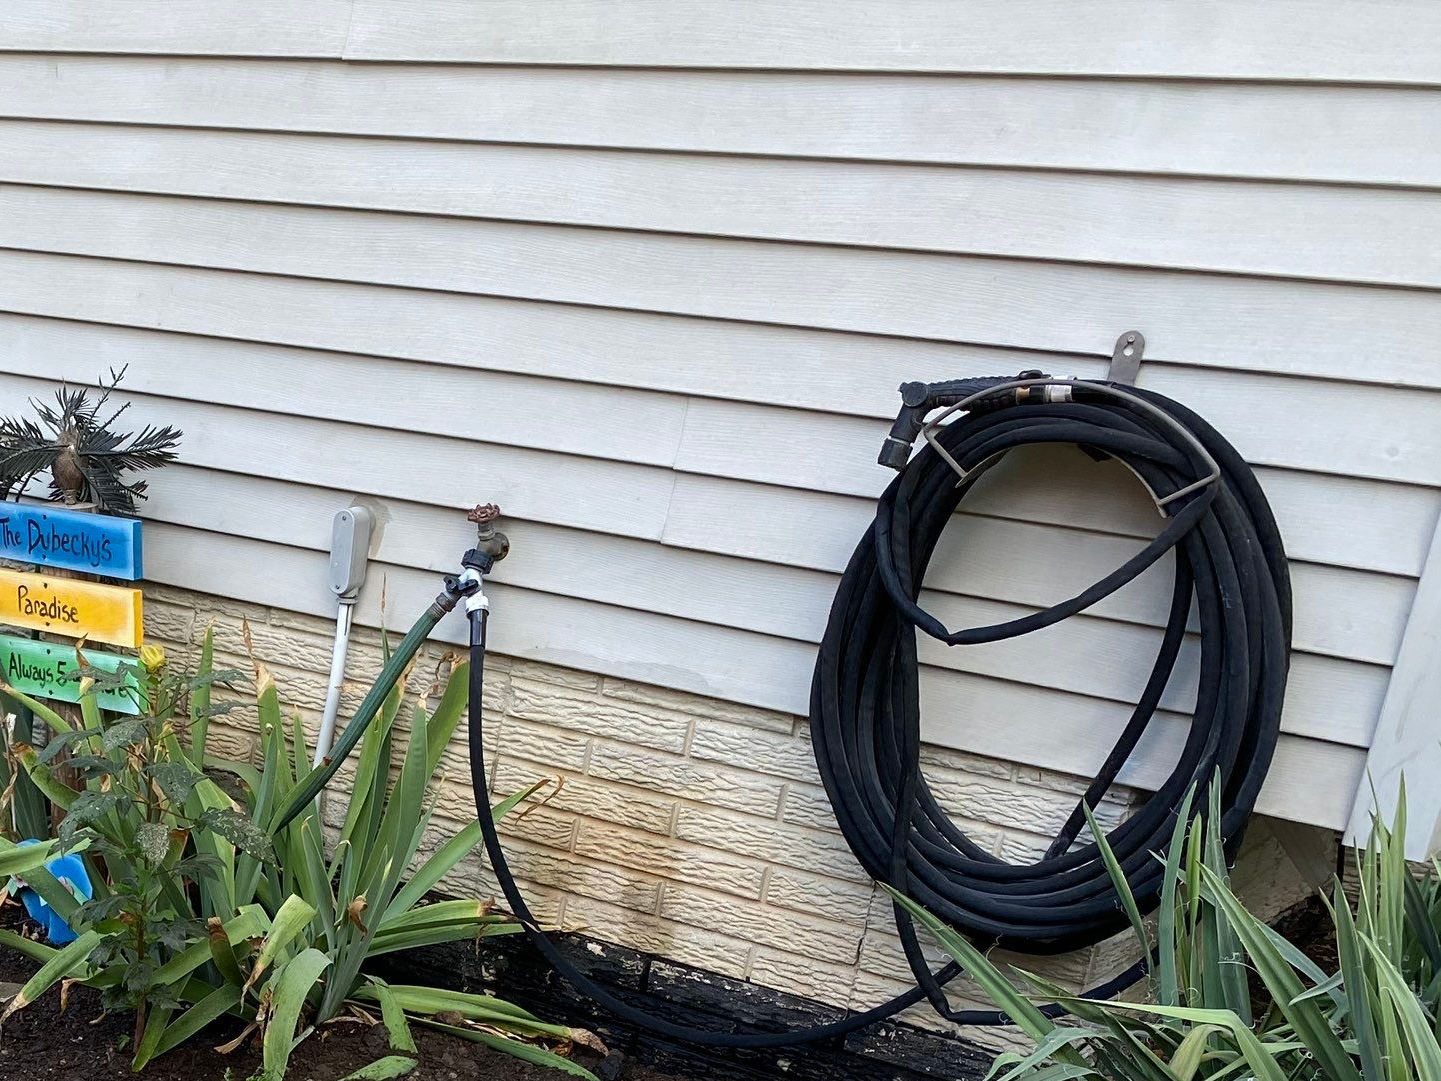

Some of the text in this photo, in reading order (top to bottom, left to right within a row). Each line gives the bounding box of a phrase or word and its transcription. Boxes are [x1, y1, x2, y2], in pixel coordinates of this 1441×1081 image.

[28, 519, 112, 567] Dubecky's
[18, 585, 79, 623] Paradise
[9, 652, 54, 688] Always
